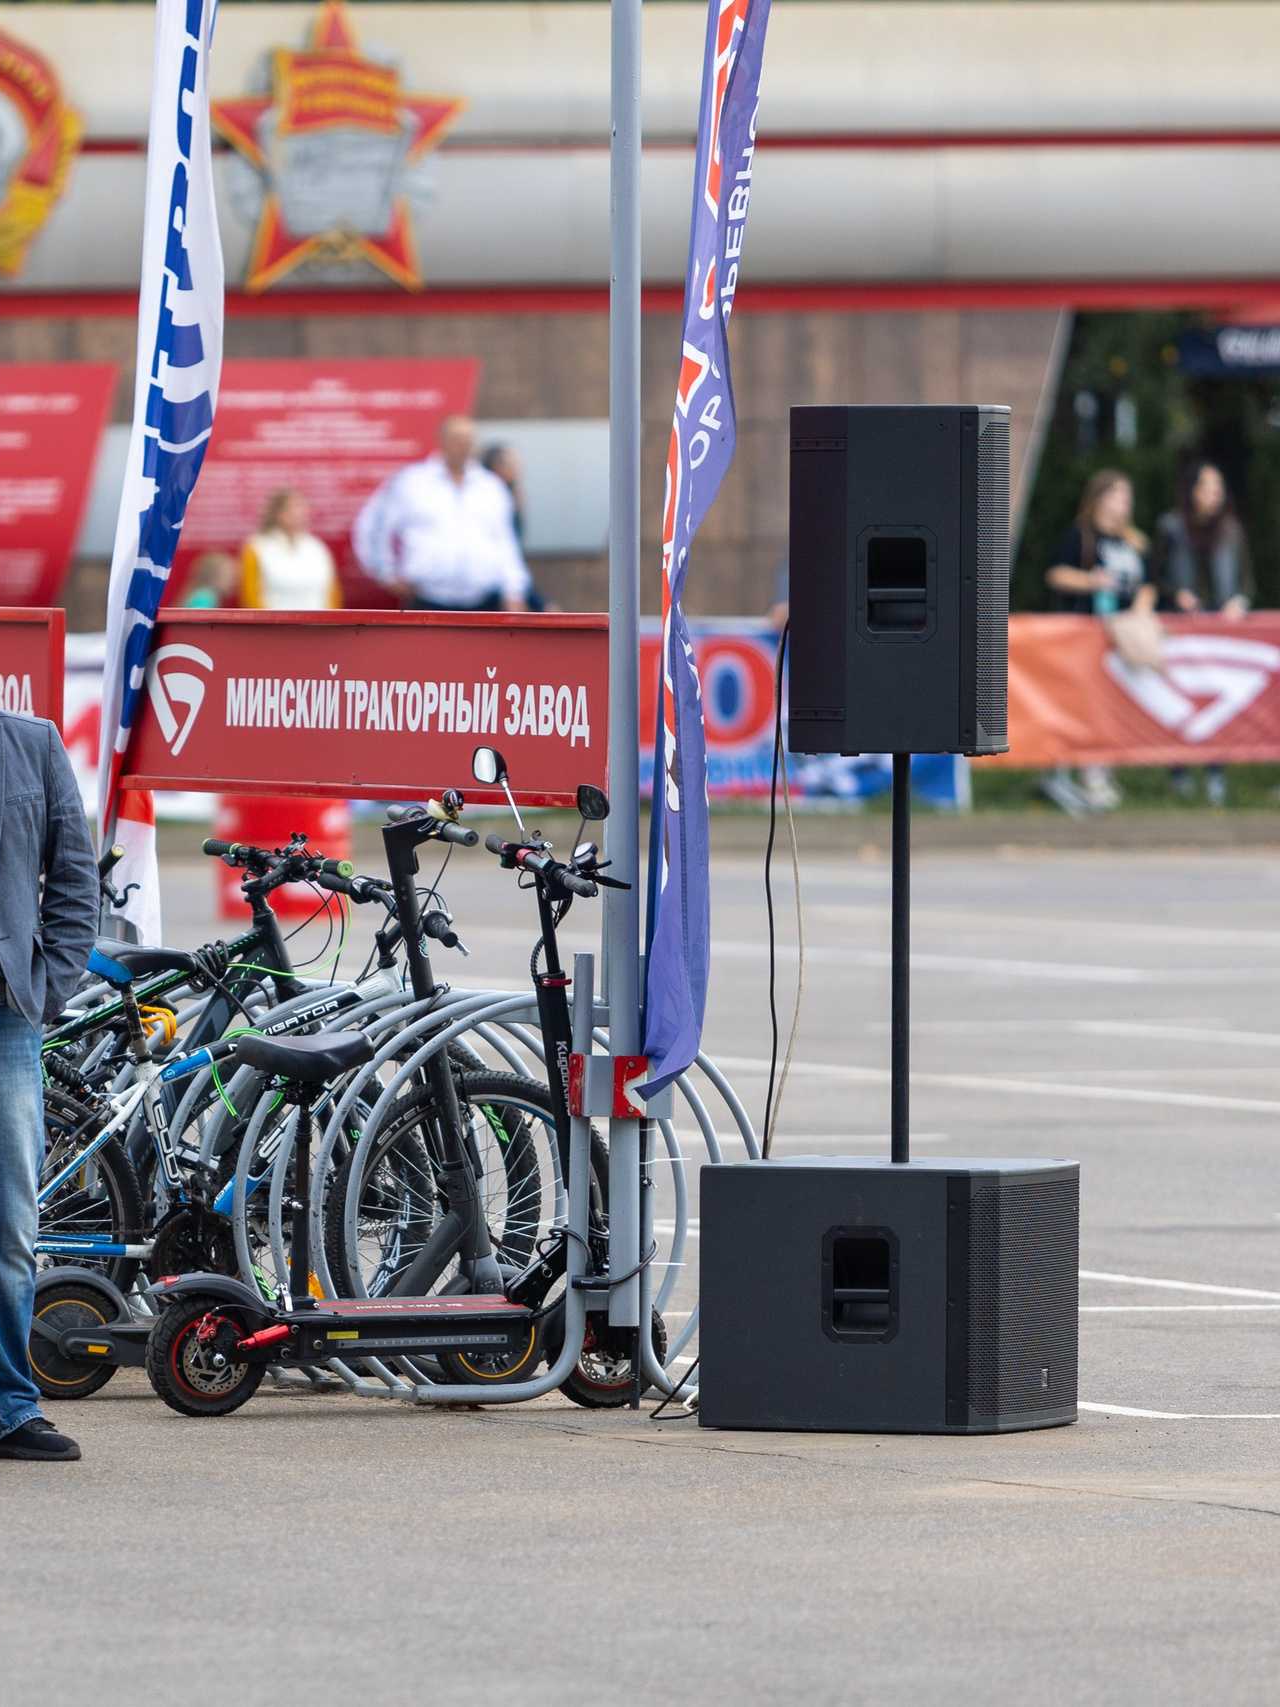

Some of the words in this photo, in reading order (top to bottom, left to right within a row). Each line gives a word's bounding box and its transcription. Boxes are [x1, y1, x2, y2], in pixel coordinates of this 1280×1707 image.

[226, 663, 339, 730] МИНСКИЙ
[344, 667, 498, 735] ТРАКТОРНЫЙ
[504, 684, 590, 748] ЗАВОД
[153, 1103, 181, 1186] 600
